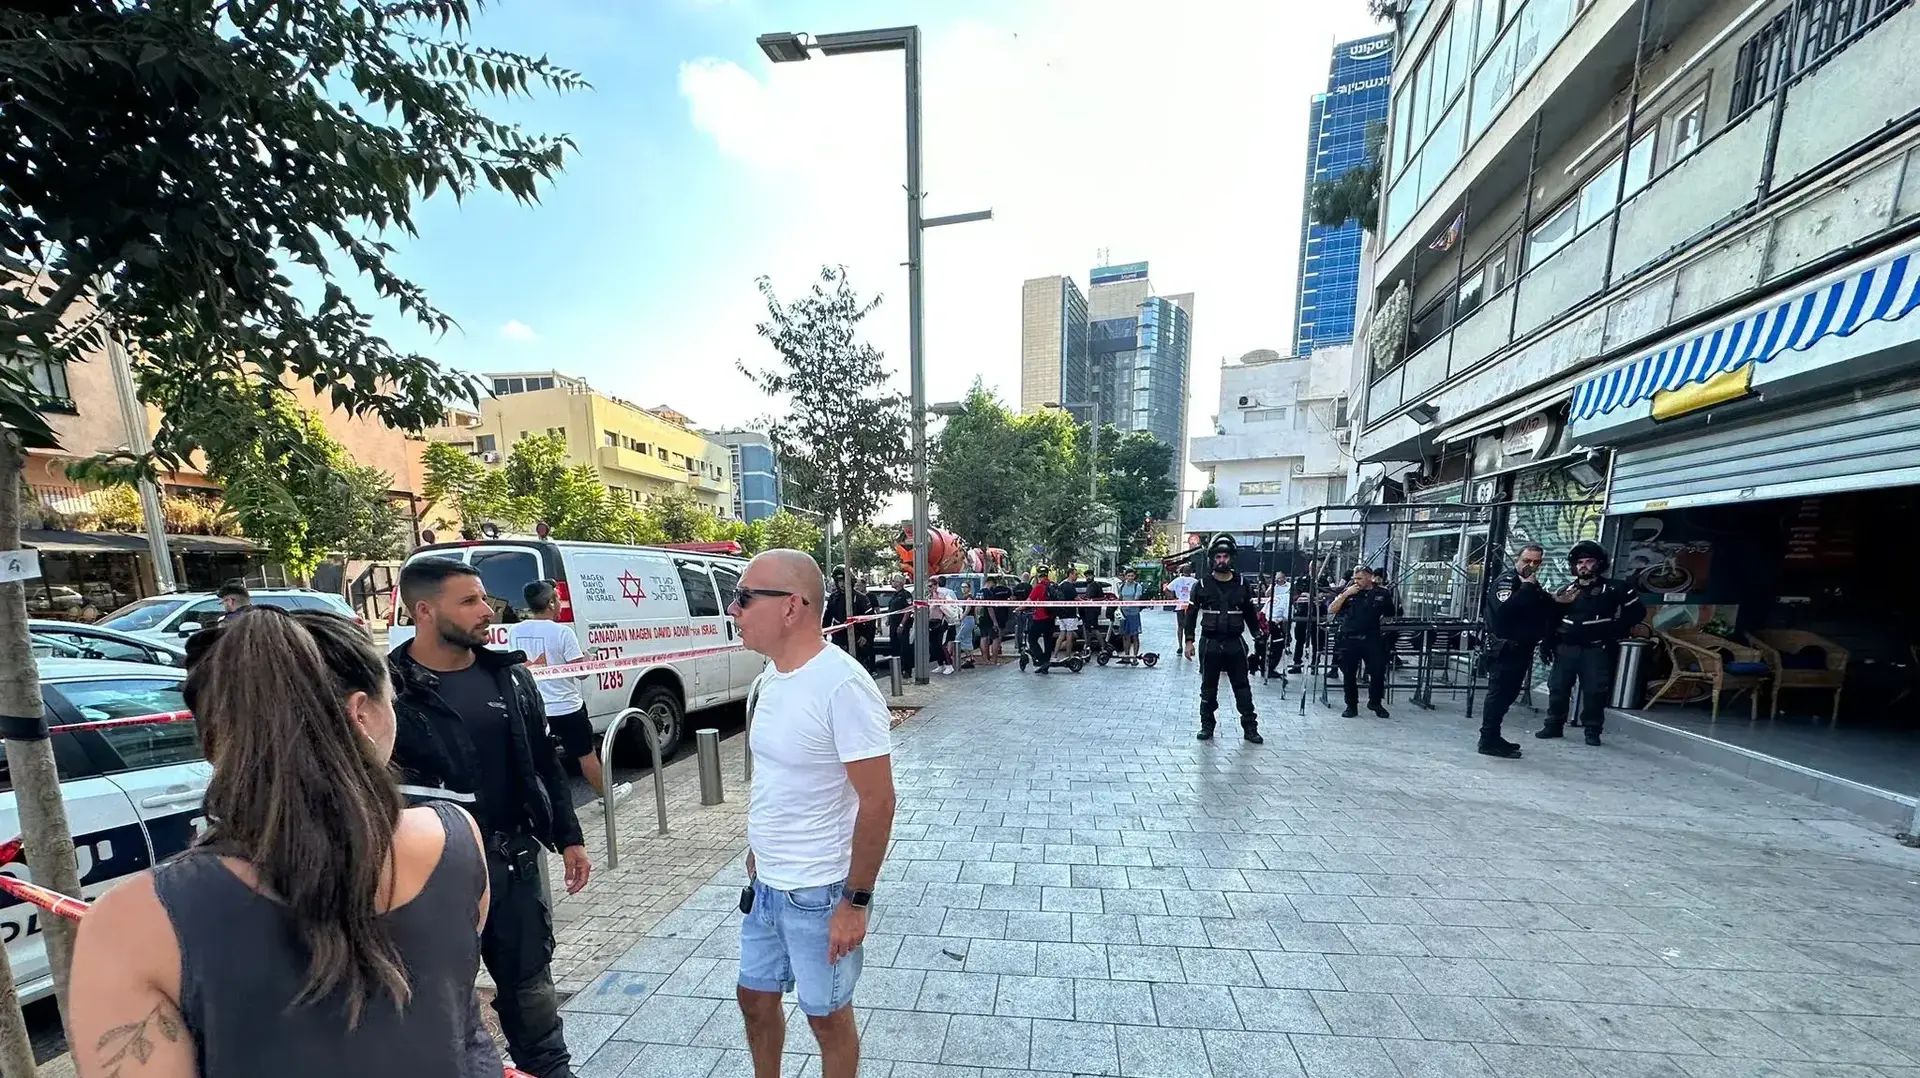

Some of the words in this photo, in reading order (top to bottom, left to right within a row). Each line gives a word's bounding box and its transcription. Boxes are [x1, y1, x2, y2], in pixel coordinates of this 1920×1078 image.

[1350, 39, 1393, 55] יסקונט
[582, 580, 604, 588] DAVID
[585, 587, 606, 595] ADOM
[586, 594, 594, 602] IN
[594, 594, 616, 602] ISRAEL
[588, 627, 628, 644] CANADIAN
[629, 627, 652, 641] MAGEN
[653, 626, 672, 639] DAVID
[673, 625, 690, 637] ADOM
[701, 623, 718, 636] ISRAEL
